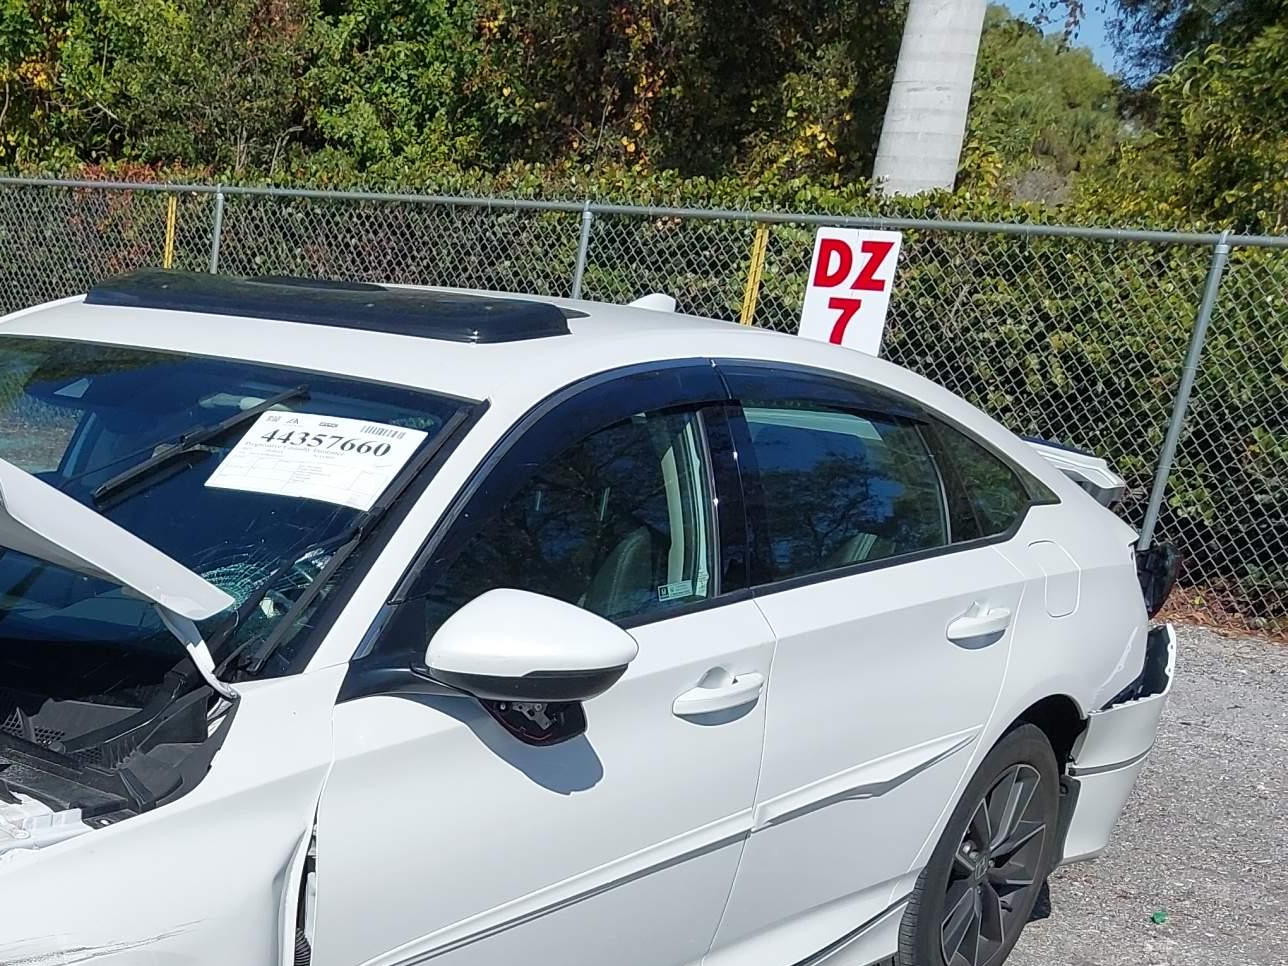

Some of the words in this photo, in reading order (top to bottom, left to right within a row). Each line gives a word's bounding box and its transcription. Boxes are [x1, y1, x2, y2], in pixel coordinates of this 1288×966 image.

[813, 238, 895, 292] DZ
[828, 297, 862, 345] 7
[261, 428, 392, 457] 44357660
